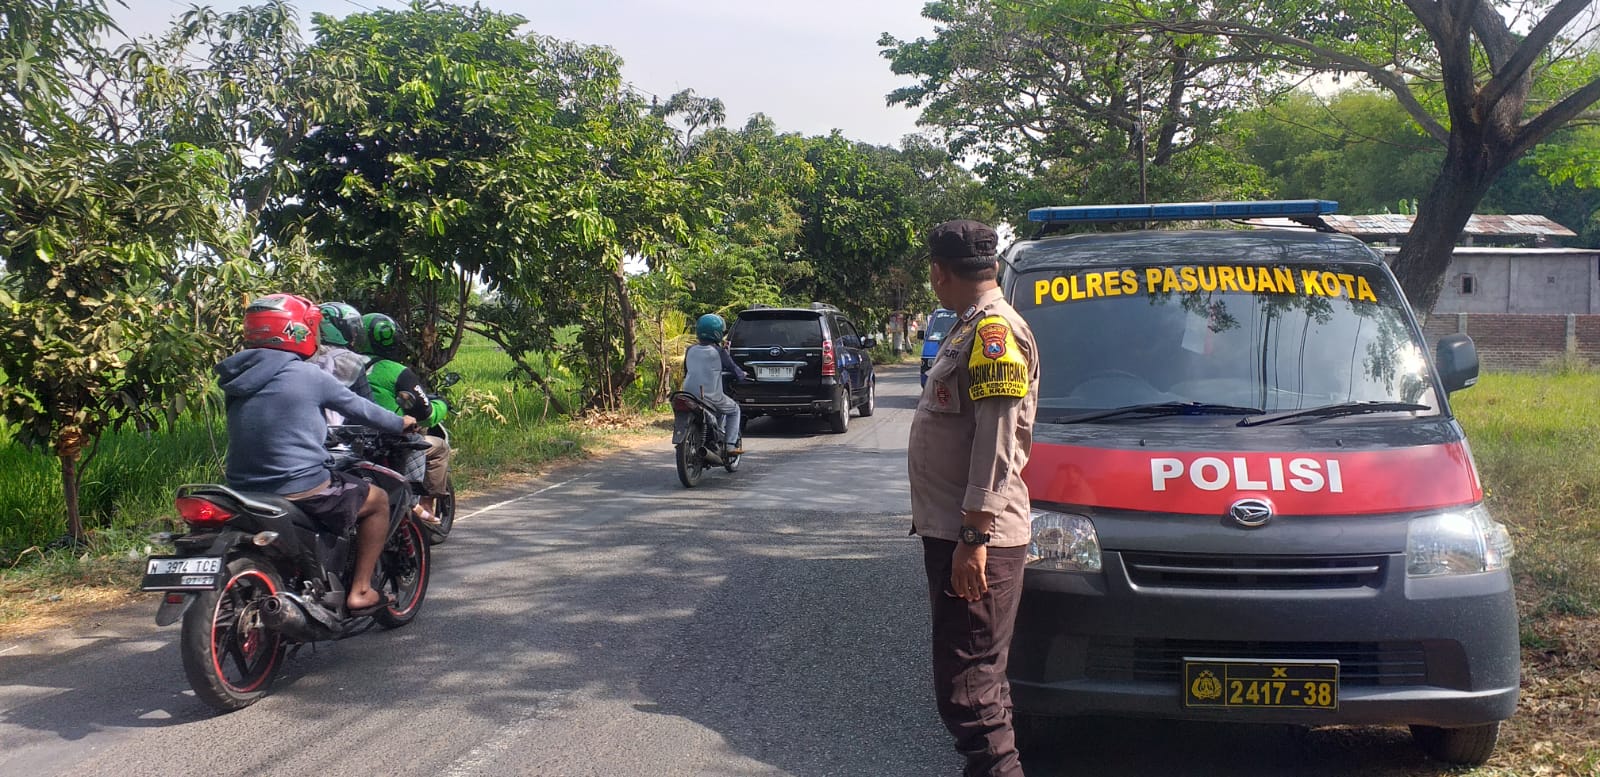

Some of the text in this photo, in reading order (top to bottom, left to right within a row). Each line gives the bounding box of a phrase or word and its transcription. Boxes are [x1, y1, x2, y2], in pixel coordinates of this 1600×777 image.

[1035, 265, 1377, 305] POLRES PASURUAN KOTA
[1150, 457, 1344, 493] POLISI
[150, 560, 217, 574] N 3974 TCE
[1272, 667, 1288, 678] X
